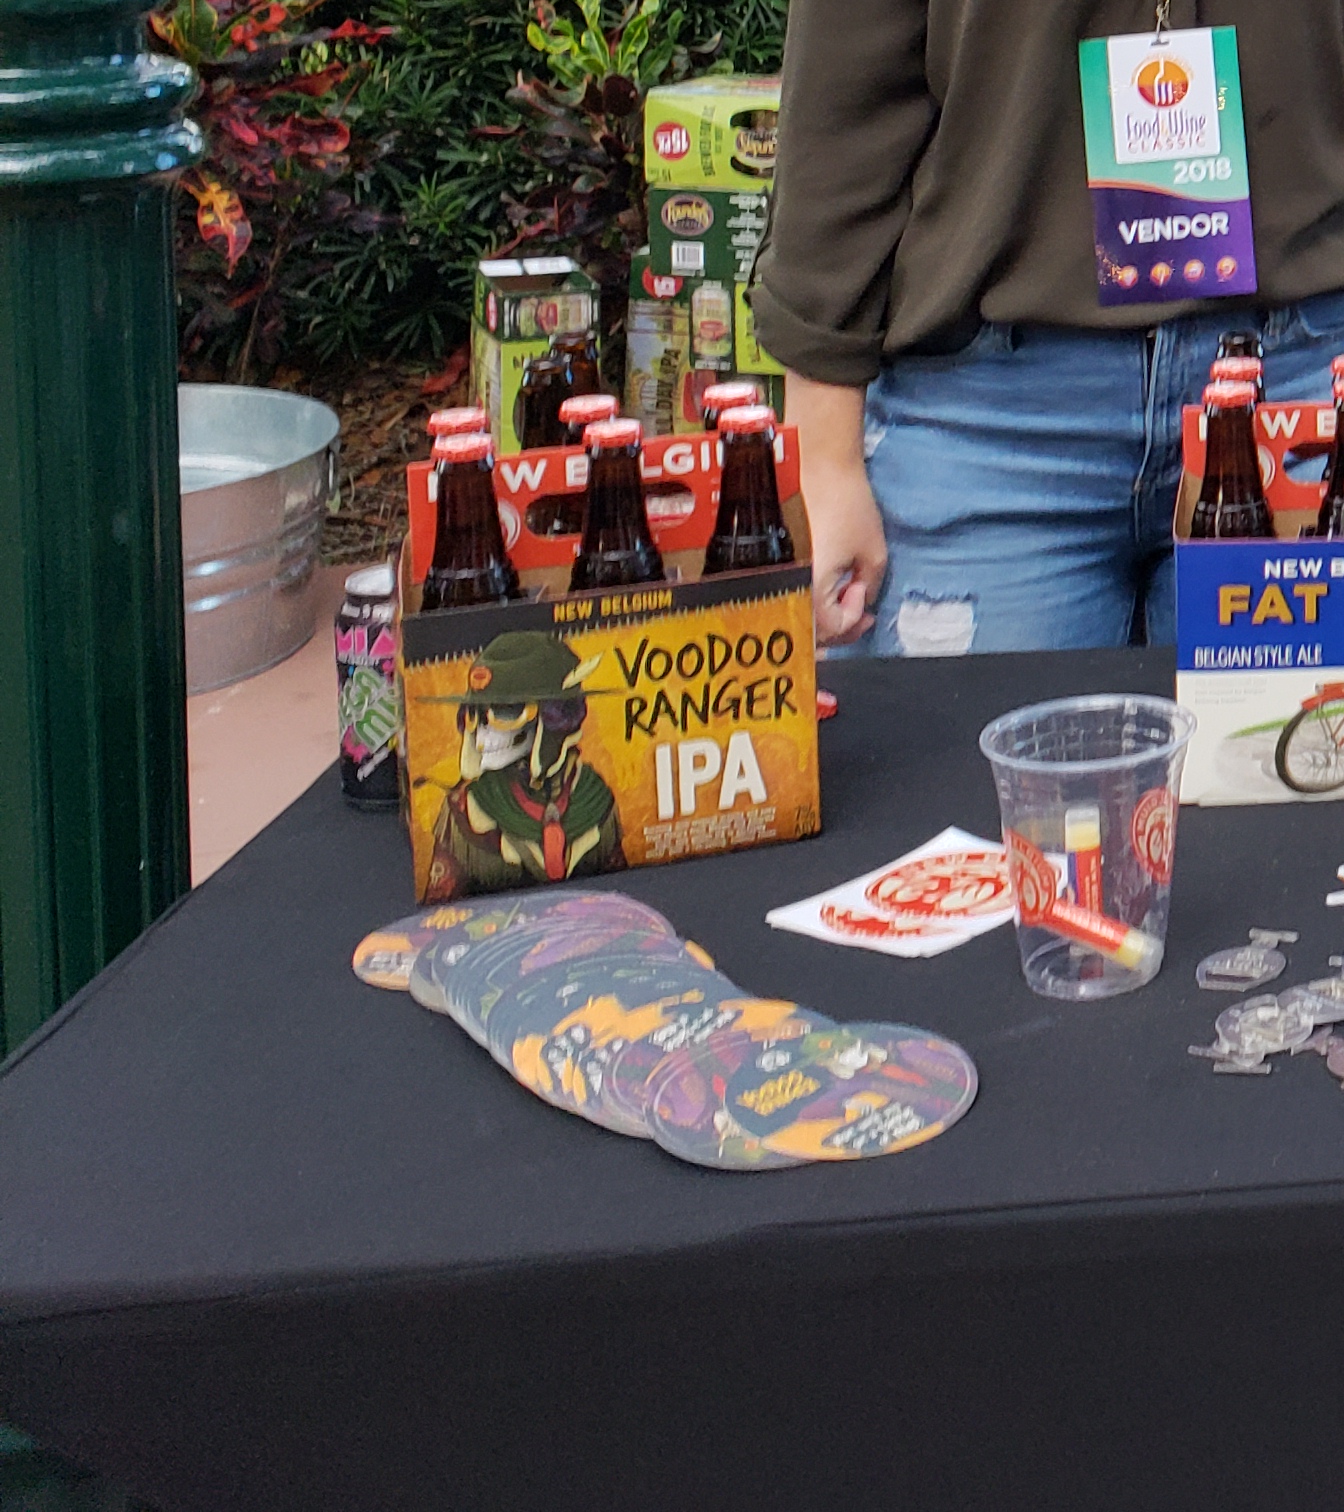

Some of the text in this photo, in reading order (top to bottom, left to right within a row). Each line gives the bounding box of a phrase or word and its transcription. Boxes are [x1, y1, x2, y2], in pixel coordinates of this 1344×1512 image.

[1173, 156, 1232, 185] 2018
[1118, 211, 1230, 245] VENDOR
[1264, 557, 1323, 580] NEW
[554, 588, 673, 623] NEW BELGIUM
[1217, 582, 1329, 627] FAT
[614, 629, 794, 688] VOODOO
[1194, 643, 1323, 669] BELGIAN STYLE ALE
[624, 676, 798, 743] RANGER
[655, 730, 768, 822] IPA
